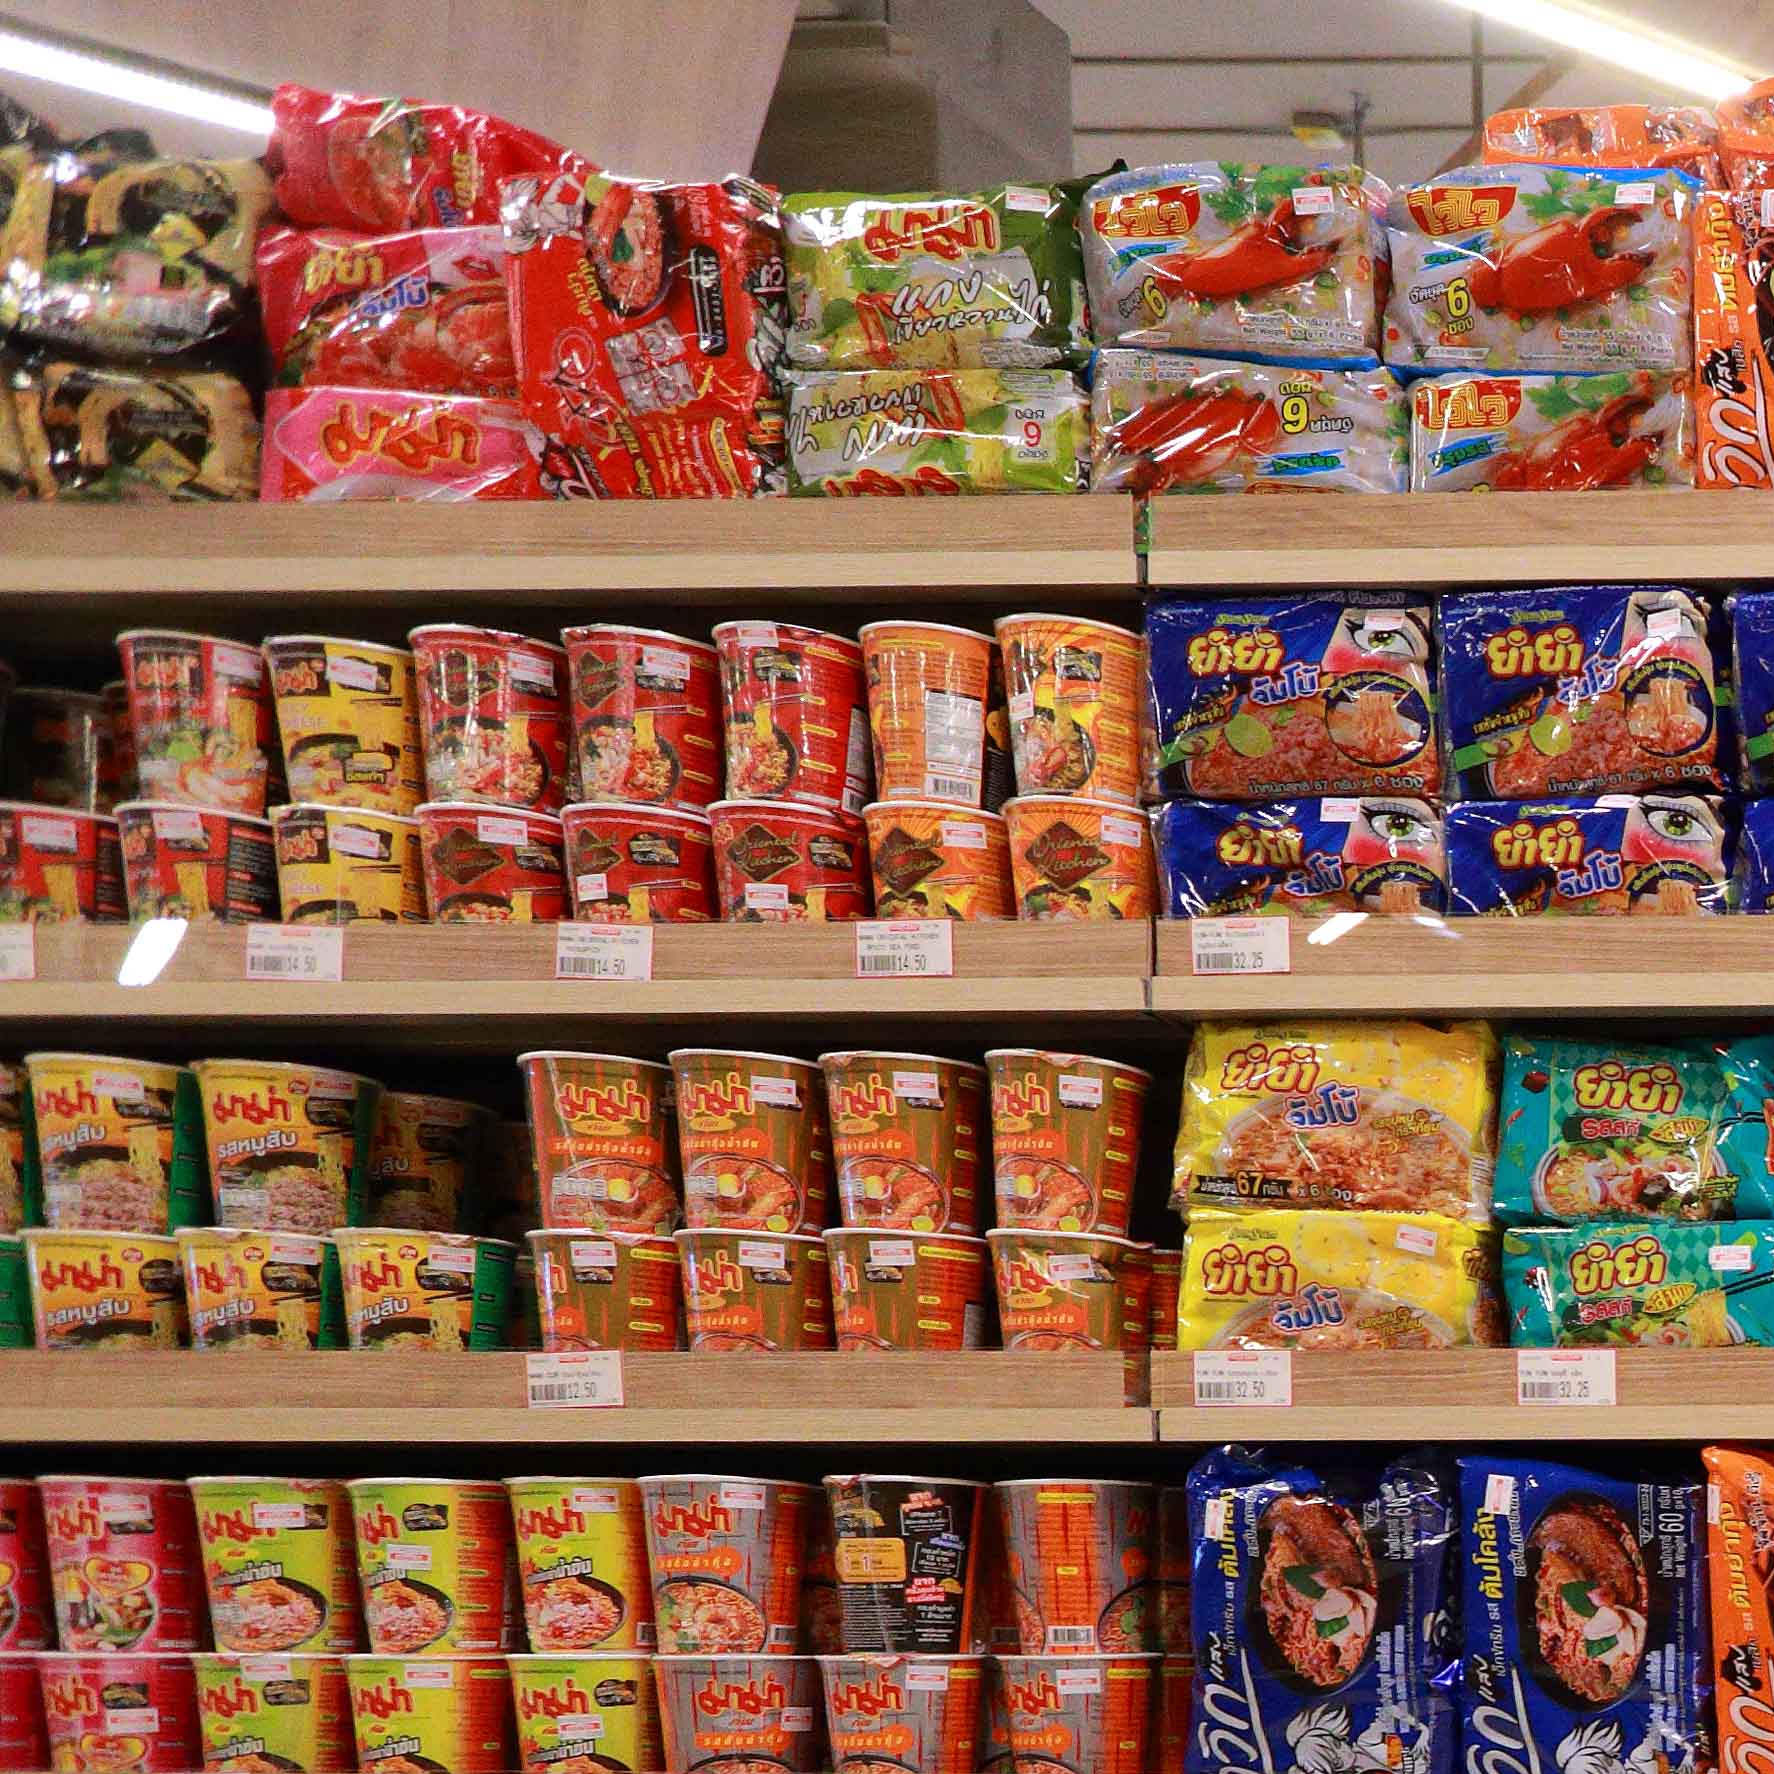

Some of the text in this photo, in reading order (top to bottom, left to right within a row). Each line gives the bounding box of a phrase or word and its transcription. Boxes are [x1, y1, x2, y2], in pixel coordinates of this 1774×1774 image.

[1446, 275, 1471, 318] 6
[1188, 628, 1281, 678] ยำยำ
[1249, 662, 1320, 708] จัมโบ้
[1556, 855, 1624, 898] จัมโบ้
[897, 952, 927, 971] 14.50
[1222, 1045, 1320, 1094] ยำยำ
[1574, 1061, 1684, 1114] ยำยำ
[1283, 1084, 1359, 1129] จัมโบ้
[1568, 1237, 1670, 1293] ยำยำ
[1271, 1282, 1343, 1331] จัมโบ้
[567, 1381, 598, 1400] 12.50
[1234, 1380, 1264, 1399] 32.50
[1559, 1381, 1589, 1399] 32.25
